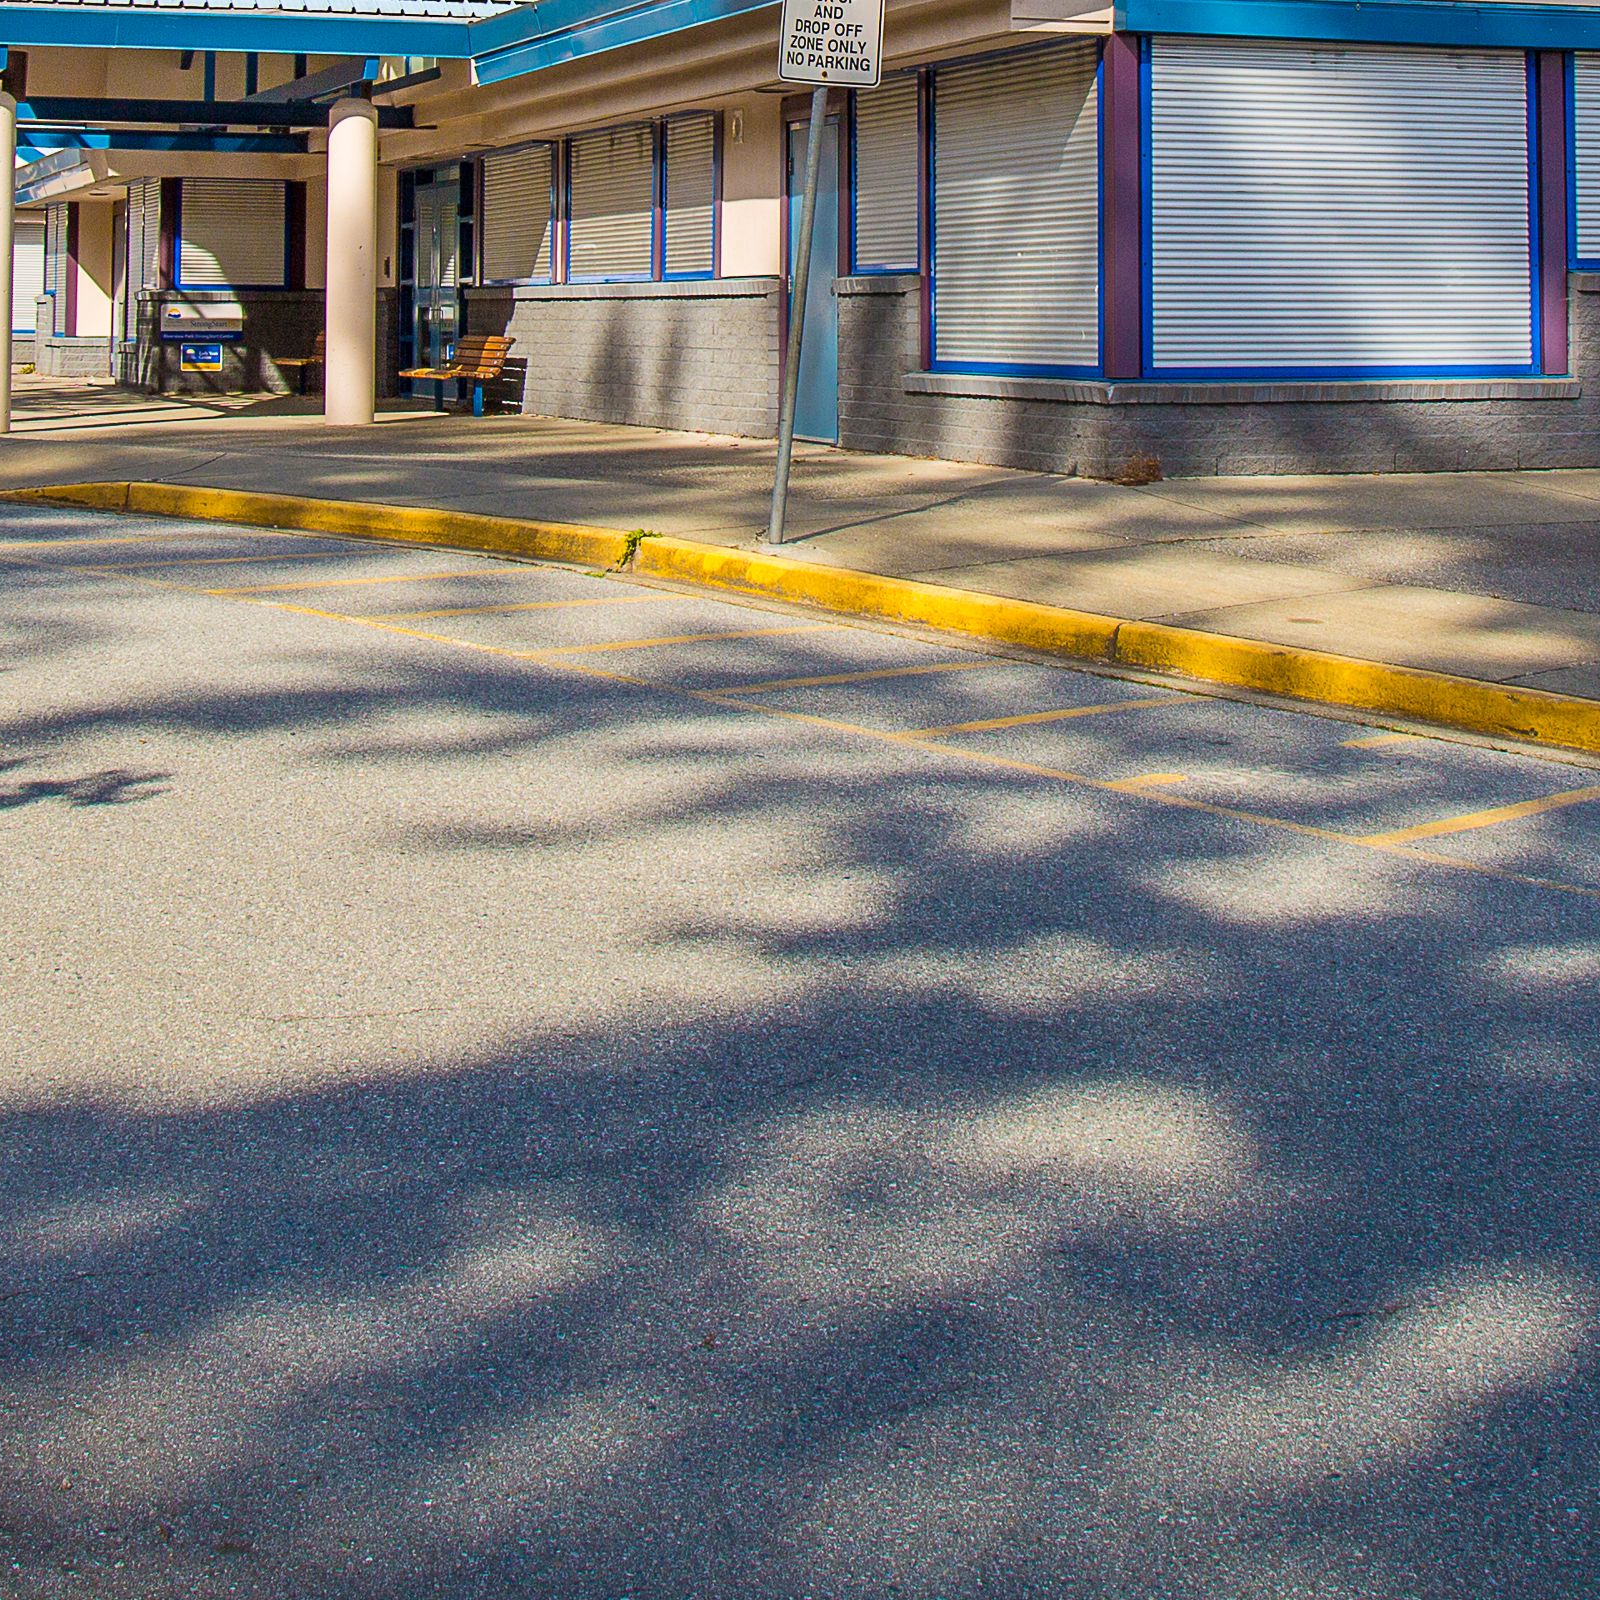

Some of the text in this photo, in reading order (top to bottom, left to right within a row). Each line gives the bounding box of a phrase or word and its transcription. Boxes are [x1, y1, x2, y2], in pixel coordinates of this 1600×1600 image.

[814, 5, 843, 19] AND
[795, 19, 863, 37] DROP OFF
[790, 35, 867, 55] ZONE ONLY
[786, 51, 871, 72] NO PARKING
